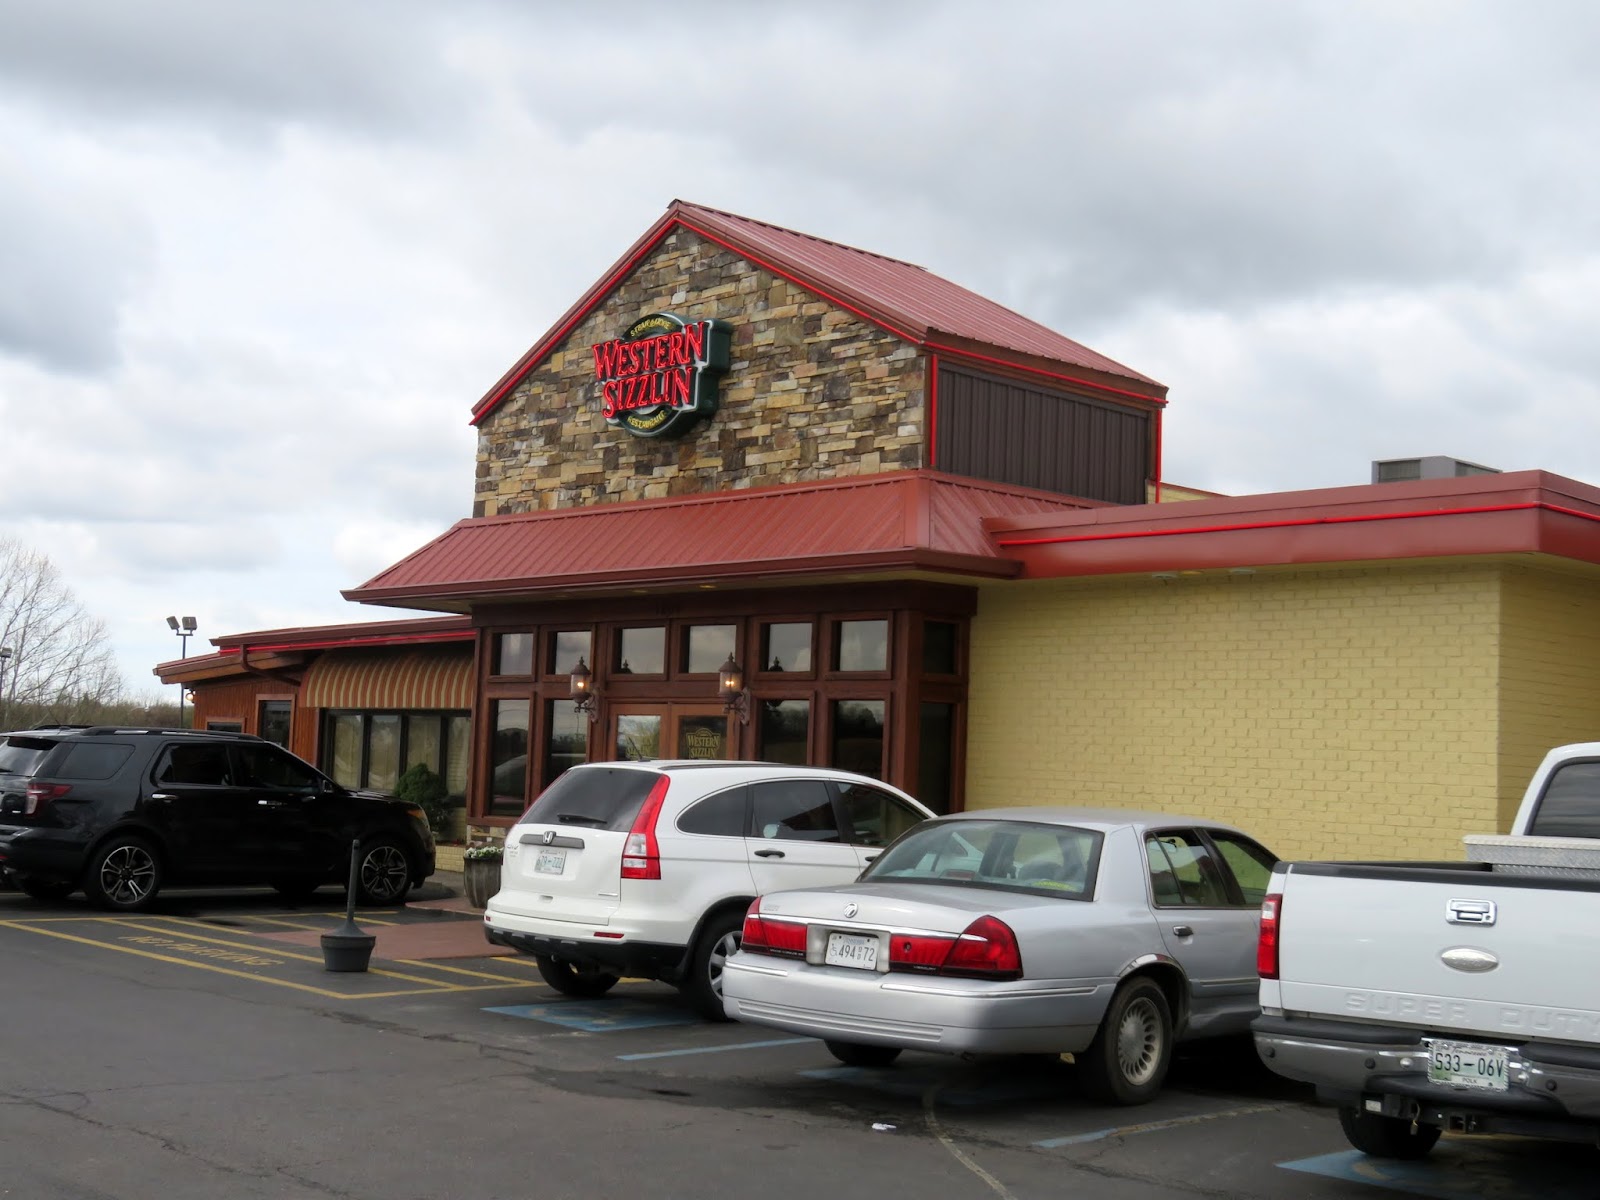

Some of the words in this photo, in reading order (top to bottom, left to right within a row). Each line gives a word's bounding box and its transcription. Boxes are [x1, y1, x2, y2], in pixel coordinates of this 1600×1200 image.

[592, 321, 704, 379] WESTERN
[602, 366, 692, 418] SIZZLIN
[687, 735, 719, 748] WESTERN
[1344, 992, 1472, 1023] SUPER
